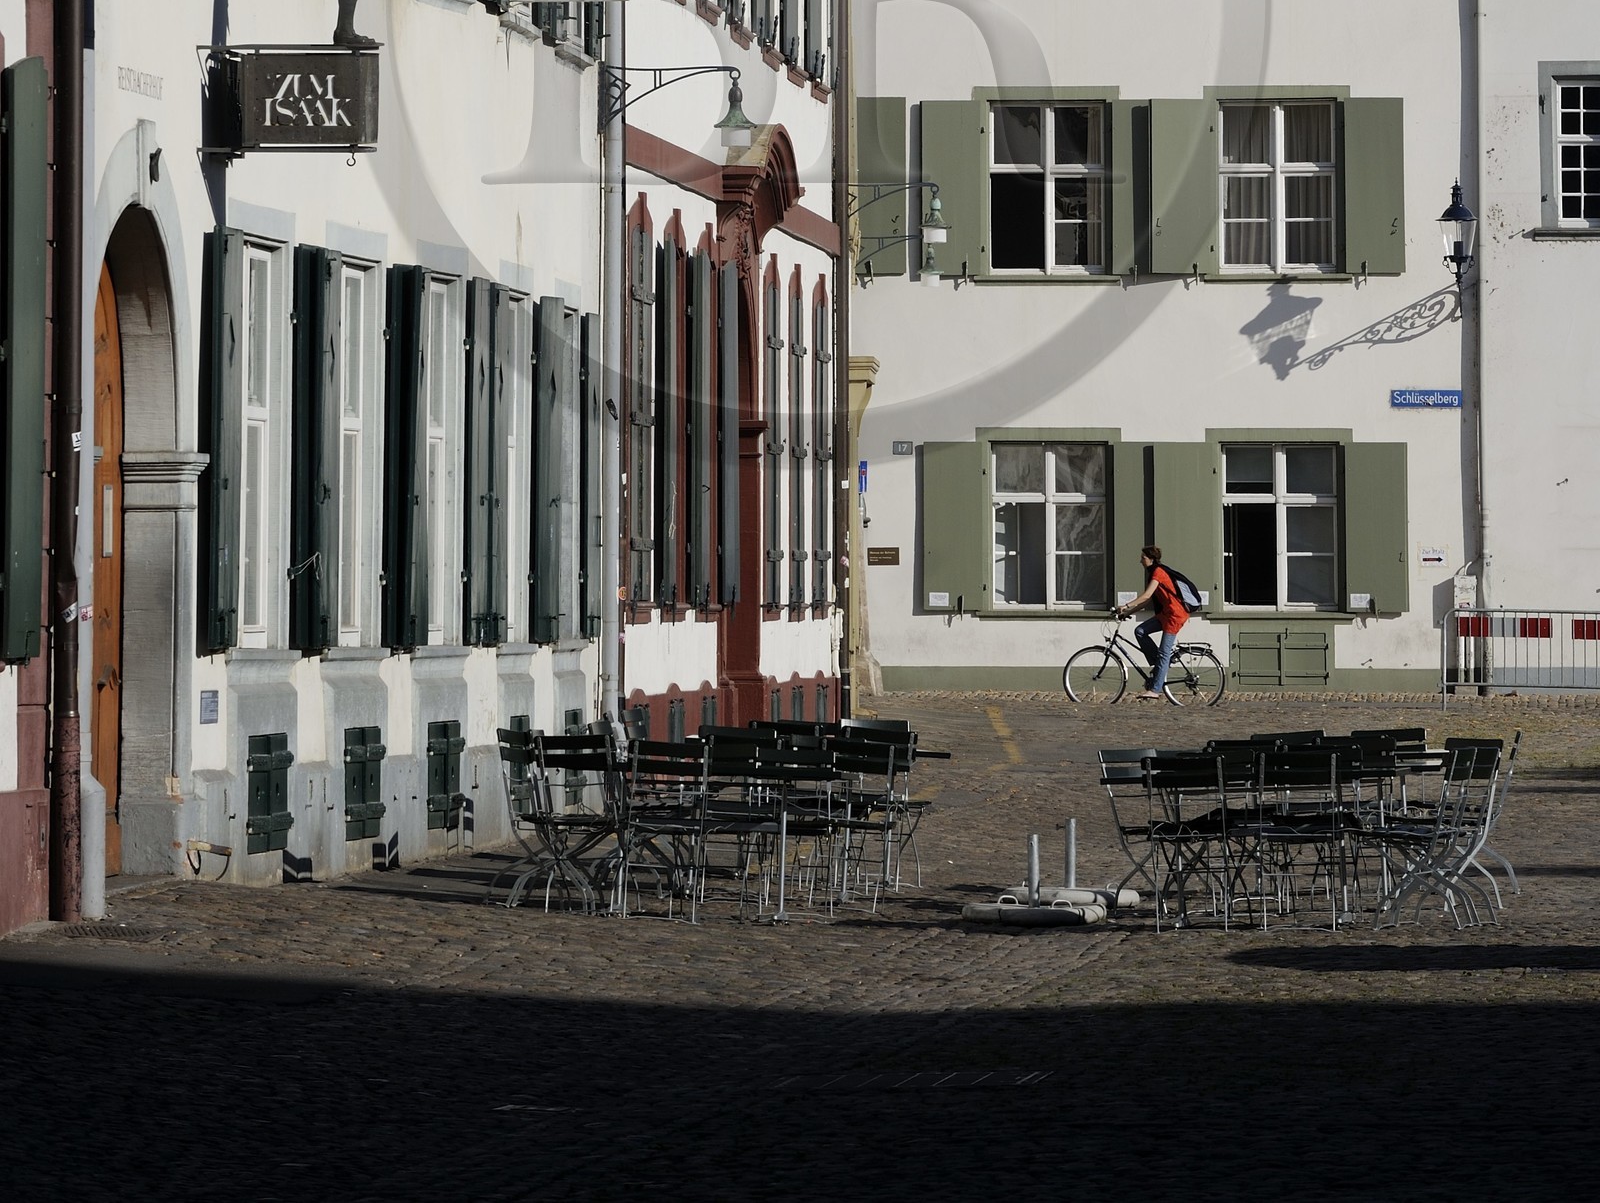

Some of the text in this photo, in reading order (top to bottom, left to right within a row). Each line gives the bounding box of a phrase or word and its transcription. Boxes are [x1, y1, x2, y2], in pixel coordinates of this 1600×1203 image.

[272, 73, 336, 99] ZUM
[262, 98, 352, 127] ISAAK
[1393, 391, 1459, 406] Schlüsselberg
[898, 443, 908, 452] 17
